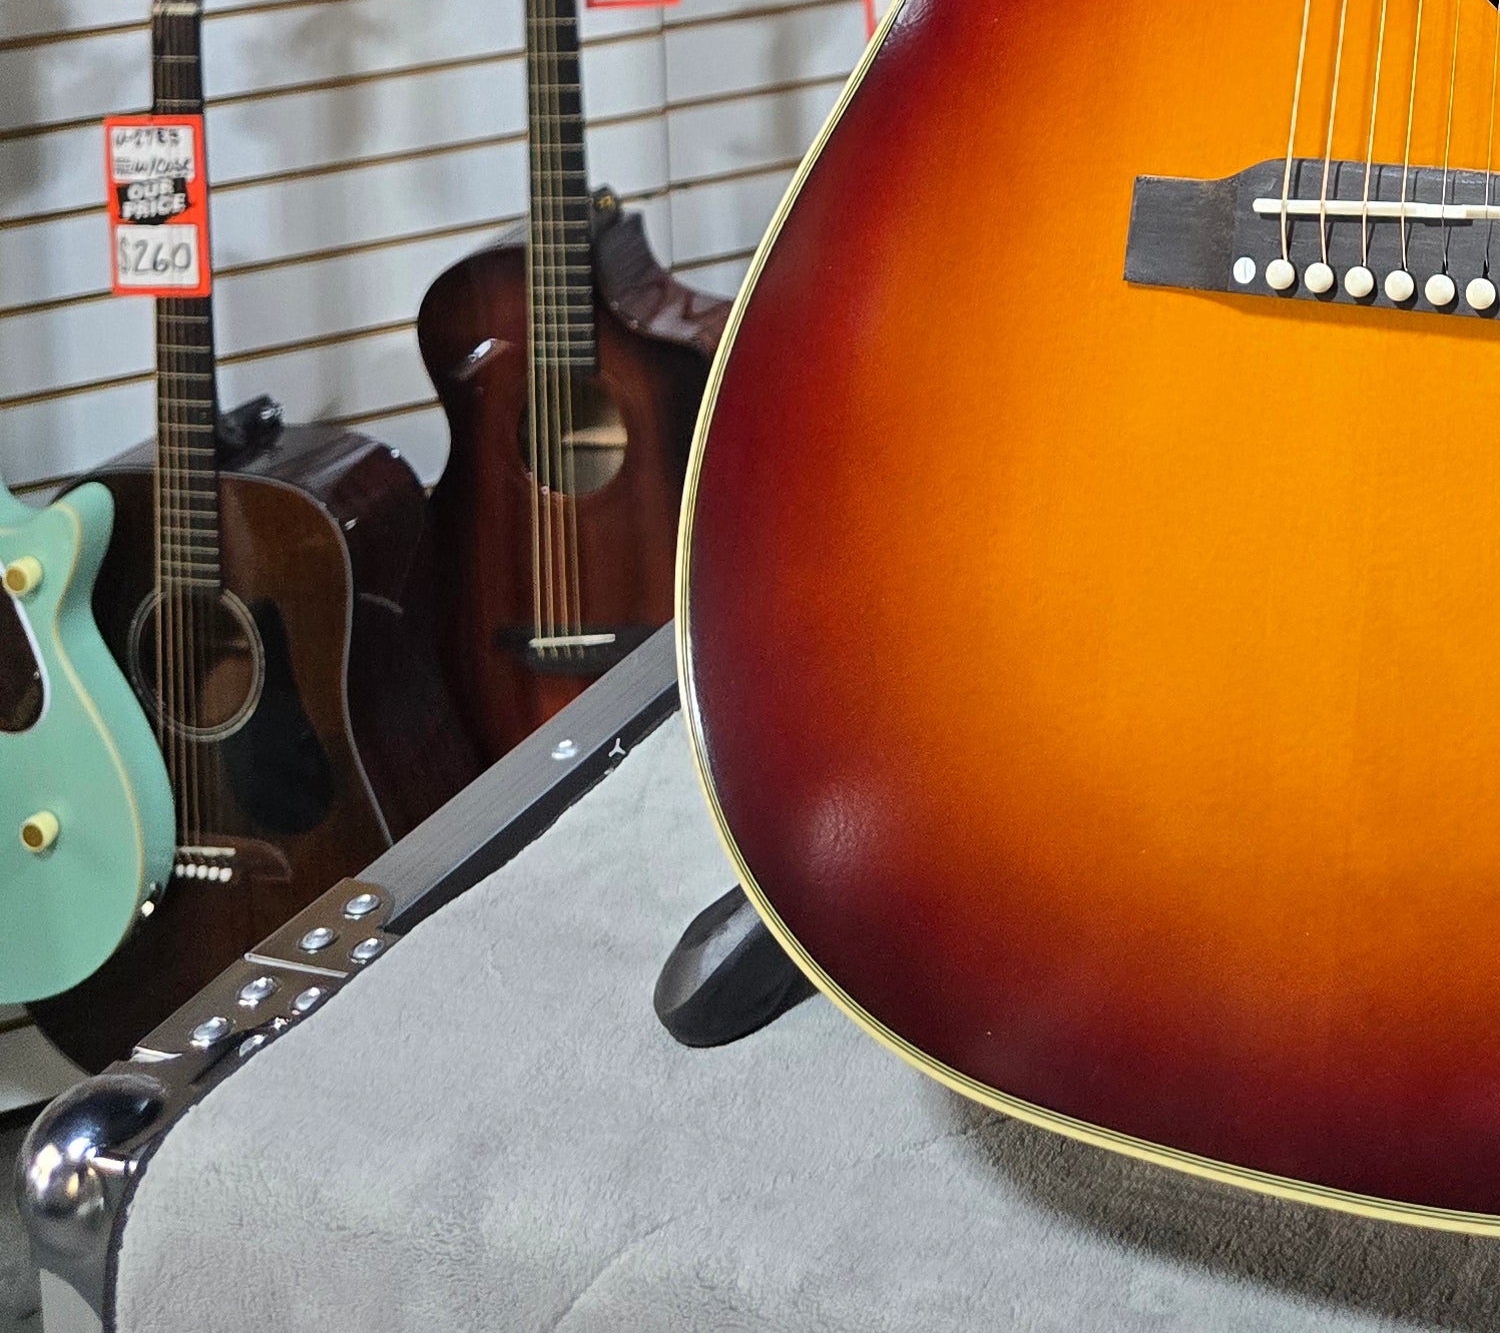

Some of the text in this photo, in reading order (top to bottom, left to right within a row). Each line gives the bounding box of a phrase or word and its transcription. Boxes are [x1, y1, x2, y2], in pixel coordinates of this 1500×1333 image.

[126, 178, 175, 202] OUR
[122, 192, 187, 220] PRICE
[119, 235, 192, 275] $260
